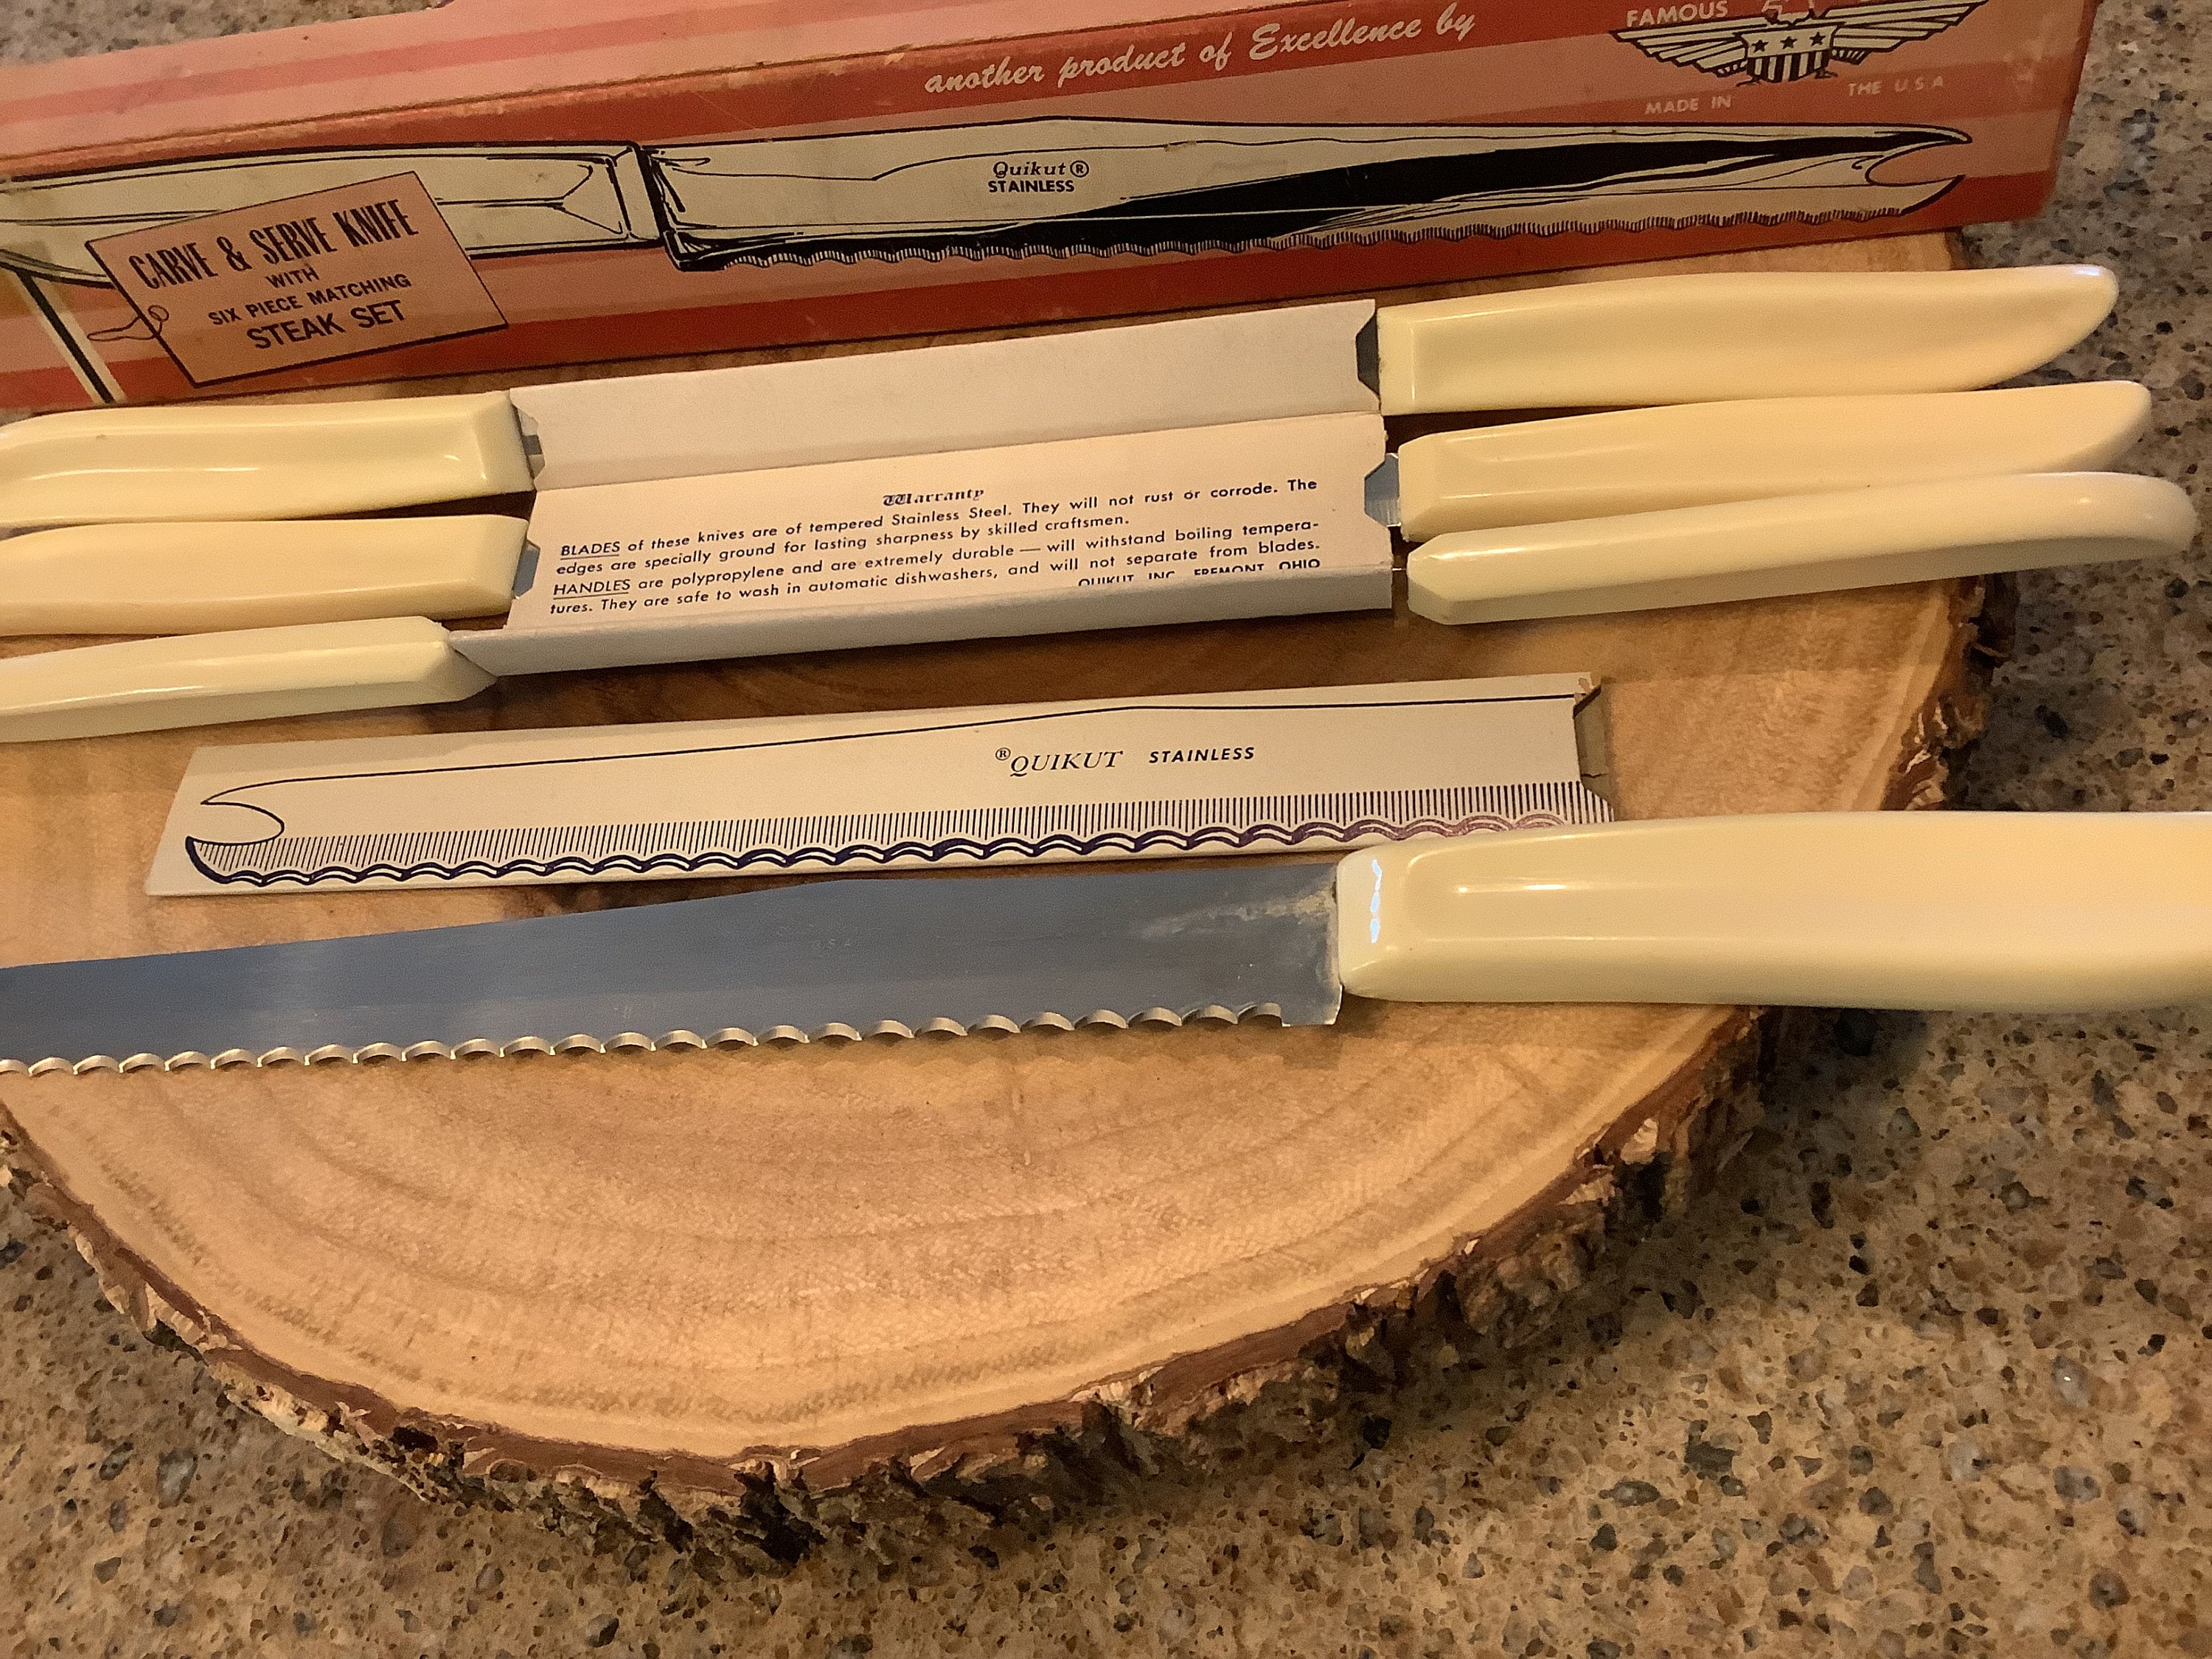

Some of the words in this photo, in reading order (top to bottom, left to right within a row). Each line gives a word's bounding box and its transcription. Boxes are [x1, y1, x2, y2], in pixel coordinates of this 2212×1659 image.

[1626, 1, 1728, 27] FAMOUS
[924, 56, 1046, 93] another
[1057, 42, 1186, 87] product
[1198, 32, 1234, 71] of
[1248, 21, 1421, 61] Excellence
[1436, 1, 1475, 41] by
[1644, 98, 1699, 115] MADE
[1711, 94, 1732, 108] IN
[1848, 81, 1882, 97] THE
[988, 180, 1075, 192] STAINLESS
[128, 243, 218, 290] CARVE
[216, 235, 252, 271] &
[249, 216, 338, 265] SERVE
[333, 199, 419, 248] KNIFE
[208, 307, 241, 325] SIX
[245, 295, 303, 319] PIECE
[305, 273, 412, 305] MATCHING
[265, 267, 320, 288] WITH
[246, 313, 345, 349] STEAK
[350, 299, 406, 328] SET
[560, 541, 621, 557] BLADES
[627, 539, 644, 552] of
[650, 536, 690, 549] these
[698, 529, 745, 543] knives
[751, 527, 778, 538] are
[785, 521, 802, 535] of
[809, 515, 883, 535] tempered
[891, 509, 959, 526] Stainless
[1023, 501, 1060, 516] They
[1069, 496, 1098, 510] will
[1108, 493, 1134, 507] not
[1144, 490, 1174, 503] rust
[1183, 489, 1201, 500] or
[1287, 479, 1318, 492] The
[883, 489, 984, 506] Warranty
[553, 579, 631, 596] HANDLES
[638, 578, 664, 589] are
[671, 565, 785, 589] polypropylene
[791, 560, 824, 574] and
[830, 560, 857, 571] are
[864, 549, 943, 568] extremely
[953, 544, 1015, 560] durable
[1046, 538, 1075, 552] will
[1085, 530, 1166, 549] withstand
[1175, 526, 1233, 542] boiling
[556, 561, 604, 577] edges
[611, 560, 636, 571] are
[644, 550, 712, 569] specially
[719, 543, 775, 562] ground
[784, 540, 807, 553] for
[813, 535, 867, 552] lasting
[876, 530, 954, 547] sharpness
[961, 525, 981, 540] by
[987, 520, 1038, 536] skilled
[601, 597, 637, 612] They
[643, 596, 669, 607] are
[677, 589, 709, 604] safe
[716, 589, 732, 601] to
[739, 582, 779, 598] wash
[787, 581, 801, 594] in
[808, 574, 888, 594] automatic
[1007, 560, 1039, 576] and
[1049, 557, 1079, 572] will
[1089, 555, 1116, 568] not
[1125, 549, 1198, 568] separate
[1209, 544, 1248, 557] from
[1149, 746, 1255, 763] STAINLESS
